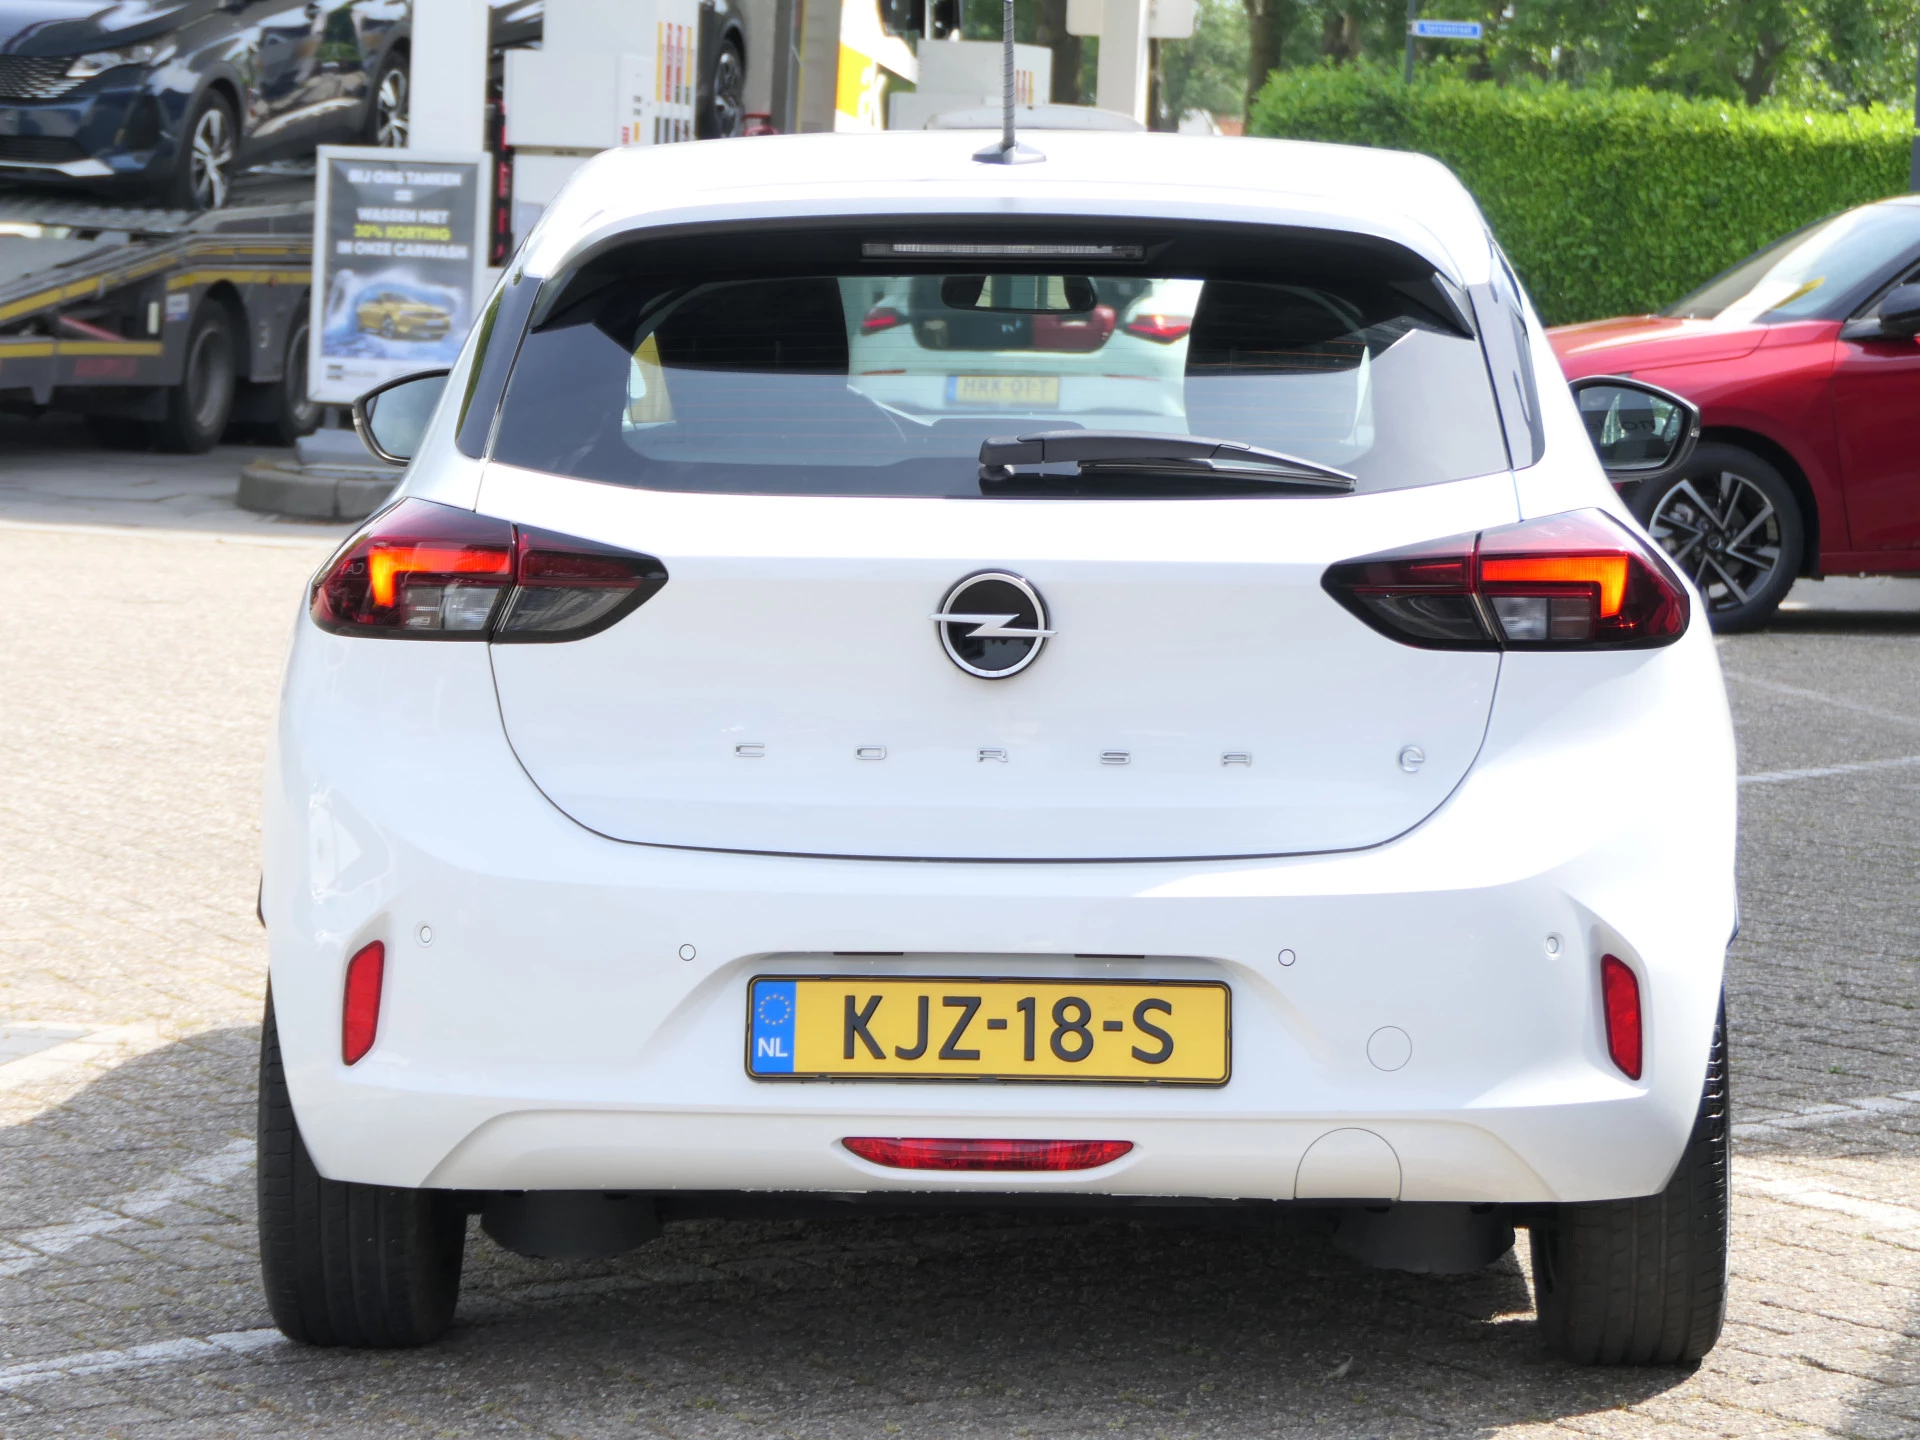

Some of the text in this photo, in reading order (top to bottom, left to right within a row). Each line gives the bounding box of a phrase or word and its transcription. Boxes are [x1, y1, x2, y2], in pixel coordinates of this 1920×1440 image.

[372, 170, 405, 185] ONS
[405, 171, 462, 186] TANKEN
[356, 208, 450, 224] WASSEN MET
[385, 225, 452, 241] KORTING
[337, 240, 468, 259] IN ONZE CARWASH
[735, 742, 1252, 767] CORSA
[842, 995, 1175, 1064] KJZ-18-S
[757, 1036, 789, 1059] NL
